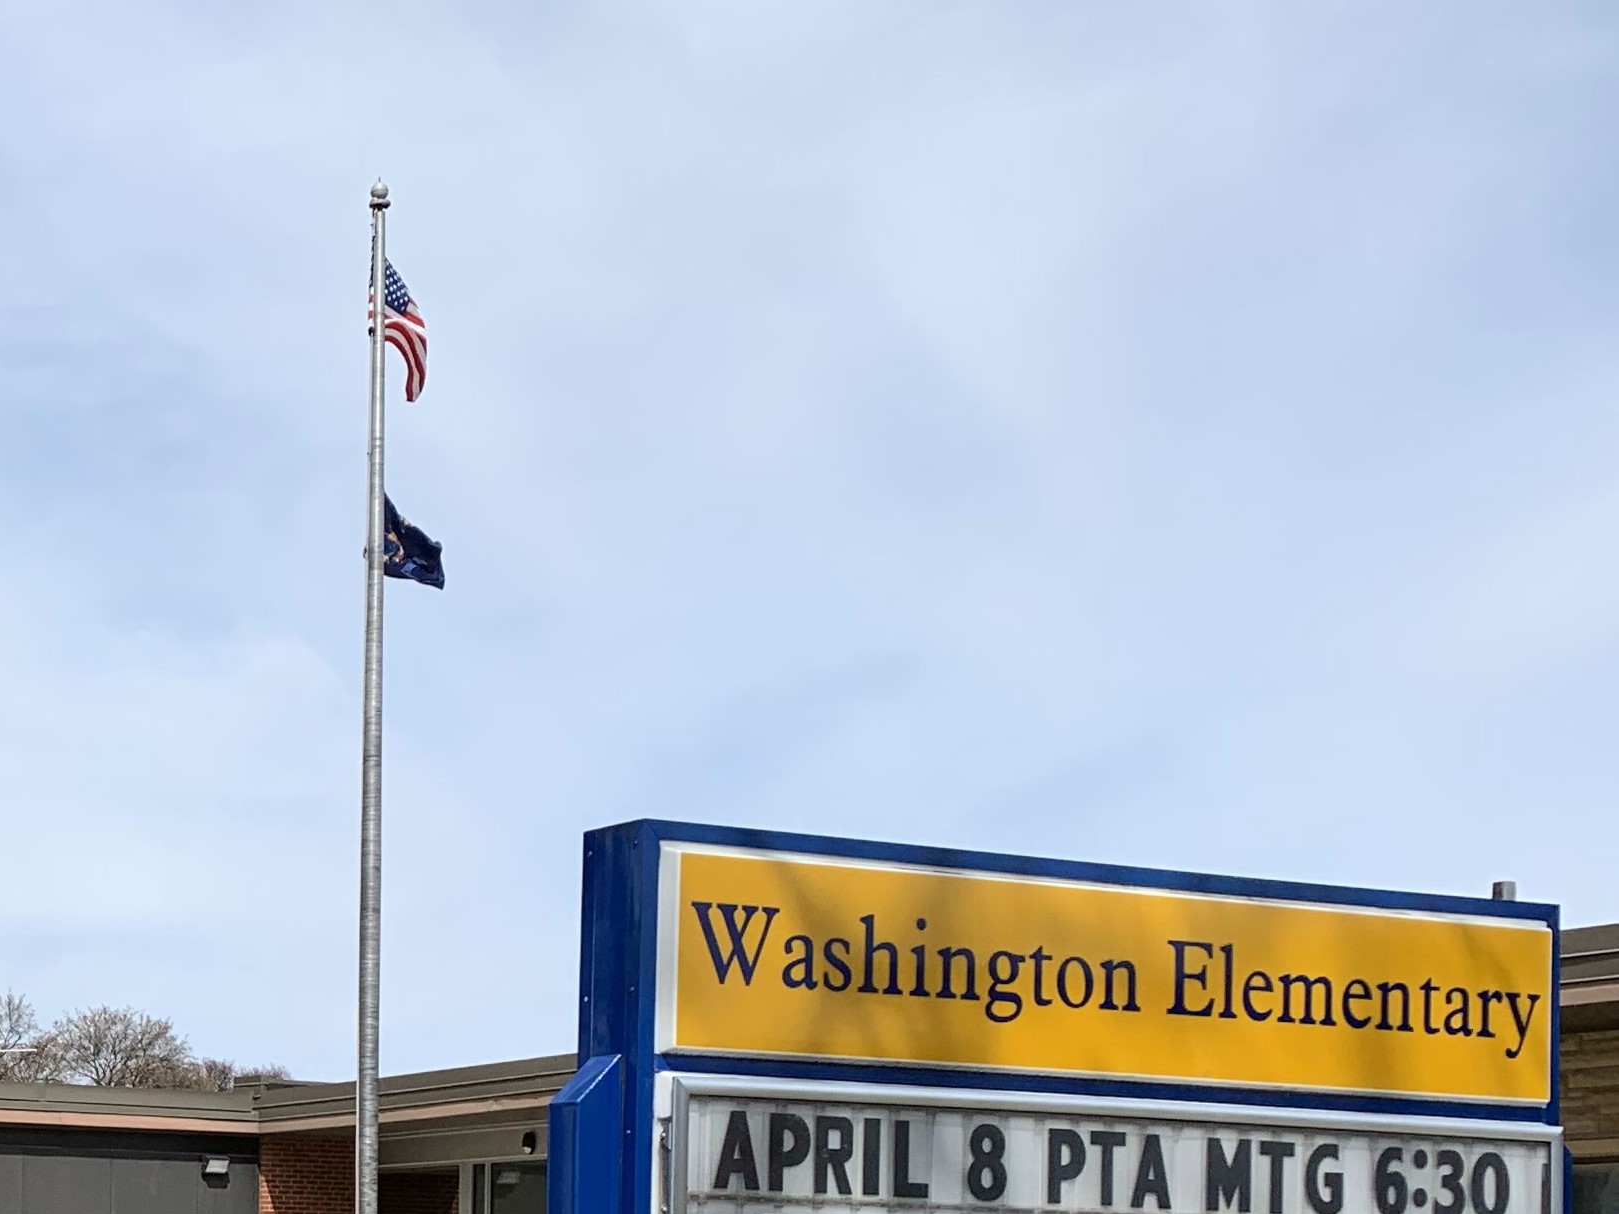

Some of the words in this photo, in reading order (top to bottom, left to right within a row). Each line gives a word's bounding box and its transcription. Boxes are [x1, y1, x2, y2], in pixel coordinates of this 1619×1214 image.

[691, 901, 1141, 1023] Washington
[1166, 940, 1541, 1059] Elementary
[713, 1110, 929, 1198] APRIL
[966, 1123, 1008, 1203] 8
[1047, 1128, 1172, 1210] PTA
